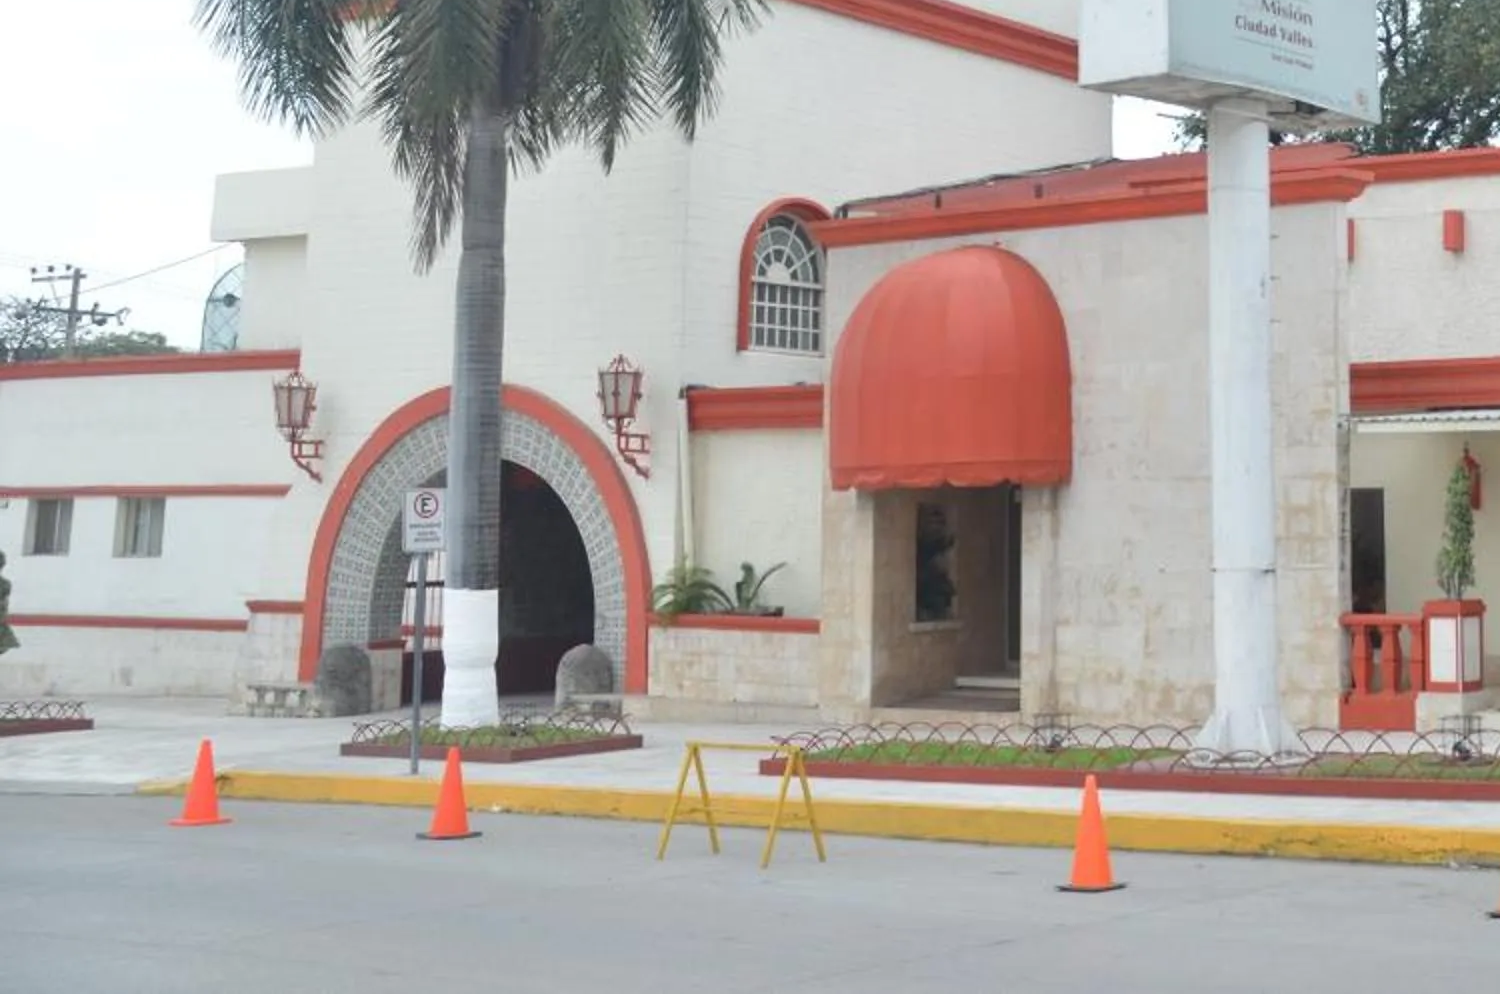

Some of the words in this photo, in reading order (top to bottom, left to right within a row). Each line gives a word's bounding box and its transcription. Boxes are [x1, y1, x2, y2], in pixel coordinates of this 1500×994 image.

[1235, 15, 1277, 38] Ciudad
[1280, 27, 1313, 48] Valles
[421, 497, 433, 513] E
